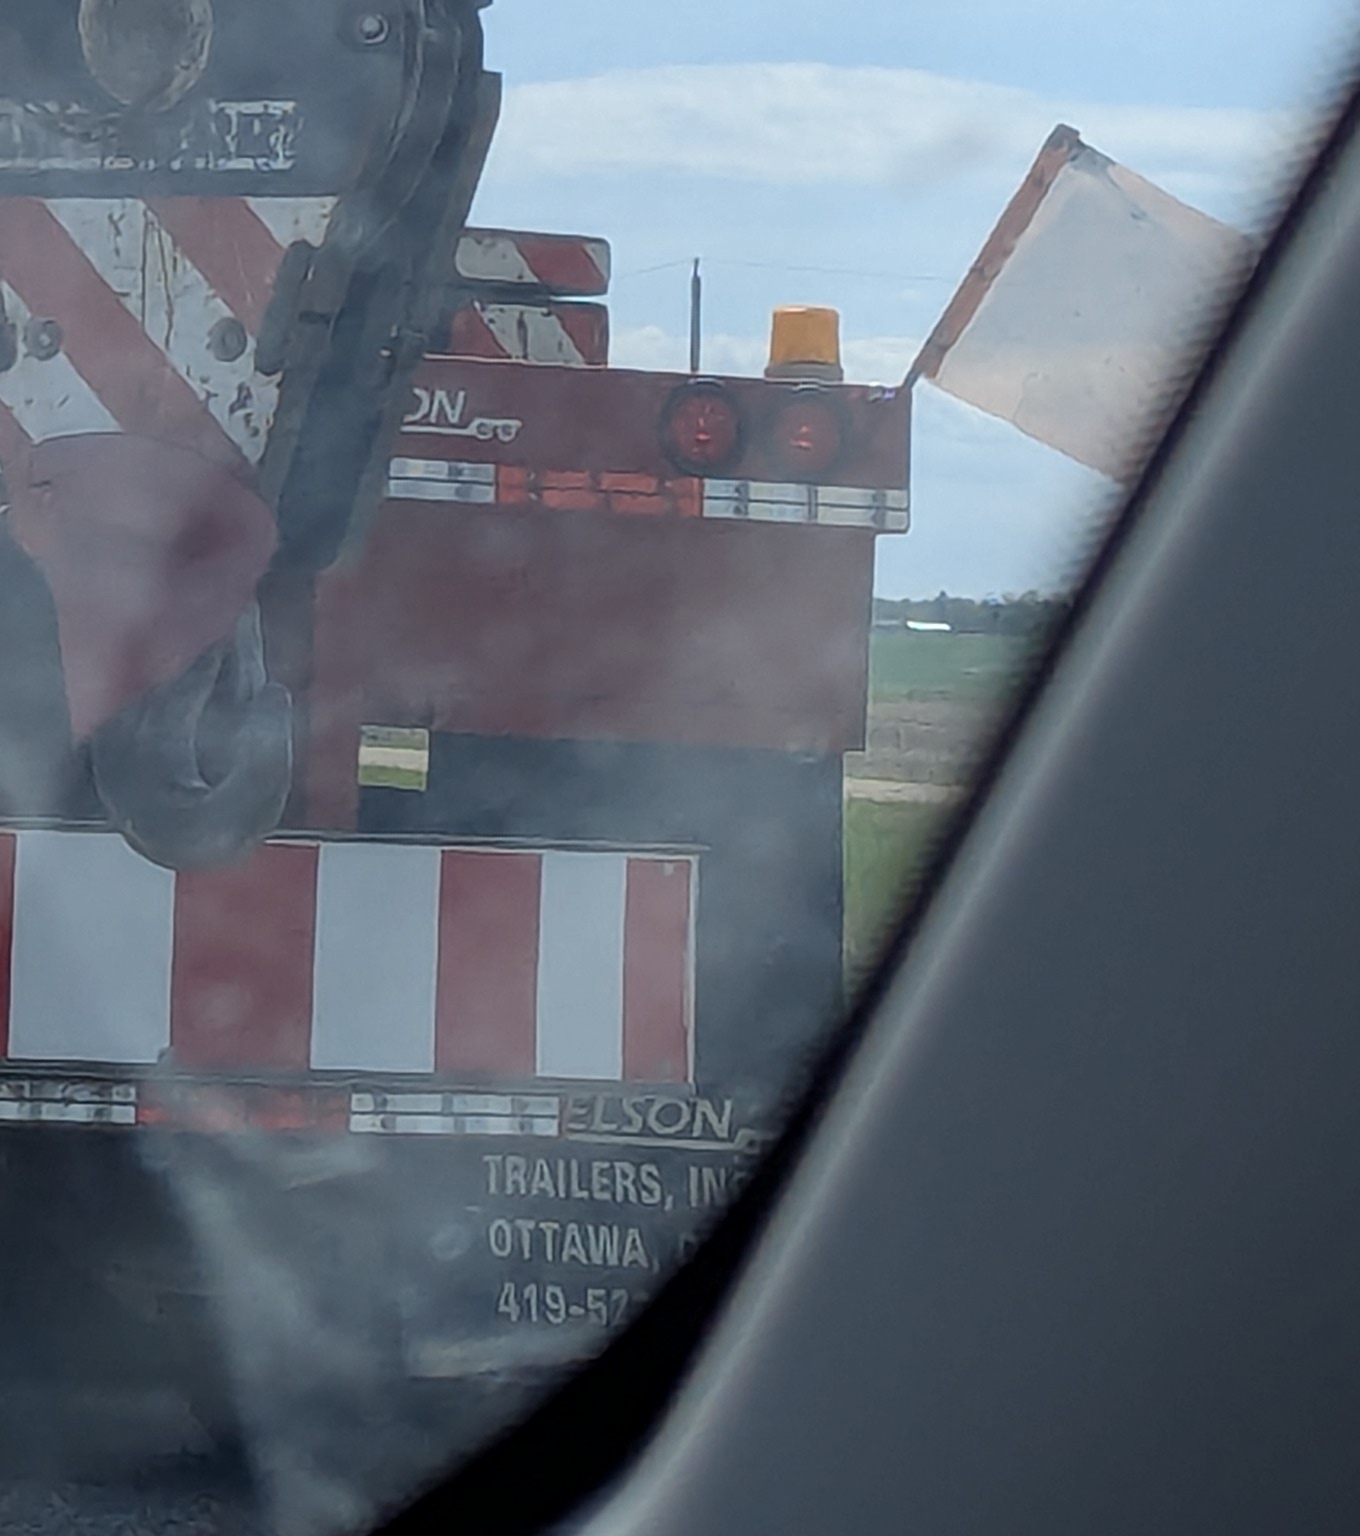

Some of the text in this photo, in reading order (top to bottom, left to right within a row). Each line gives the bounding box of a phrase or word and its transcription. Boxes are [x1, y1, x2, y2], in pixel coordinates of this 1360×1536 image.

[566, 1095, 733, 1139] ELSON
[482, 1155, 674, 1212] TRAILERS,
[488, 1217, 661, 1273] OTTAWA,
[497, 1281, 638, 1326] 419-52
